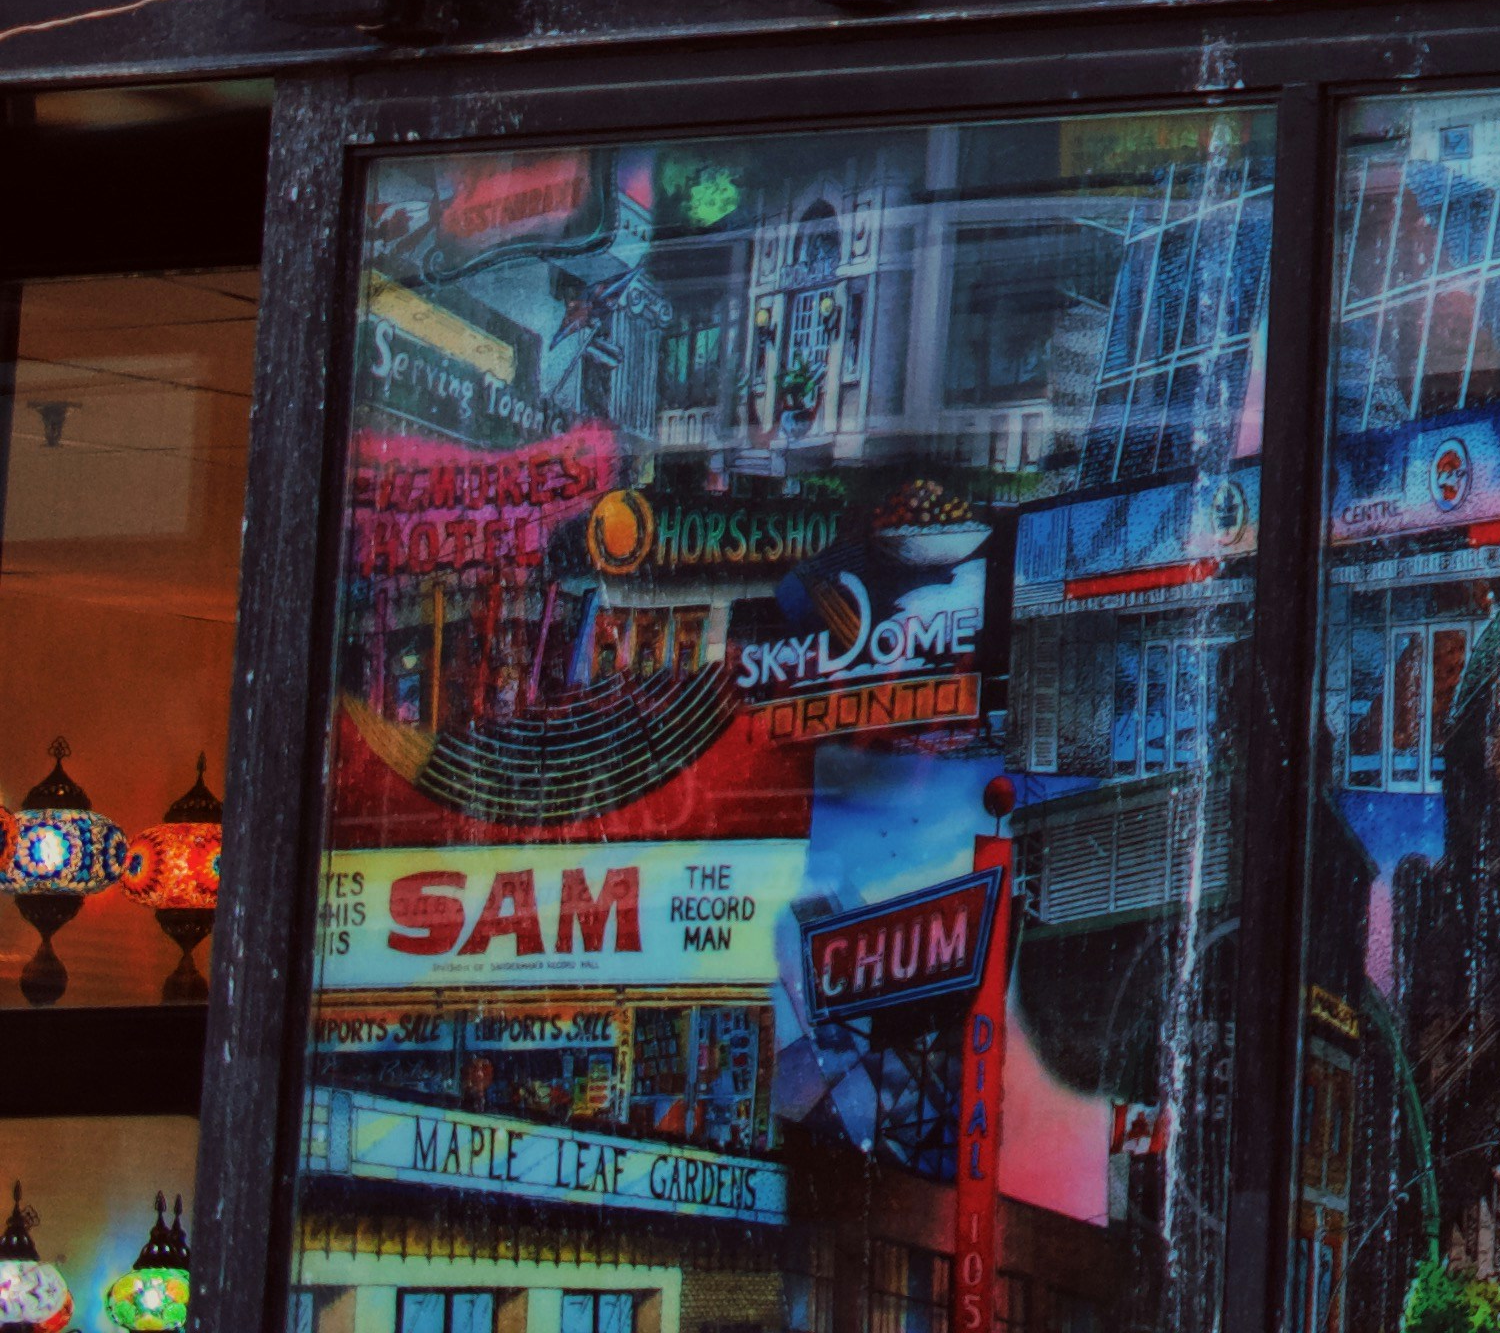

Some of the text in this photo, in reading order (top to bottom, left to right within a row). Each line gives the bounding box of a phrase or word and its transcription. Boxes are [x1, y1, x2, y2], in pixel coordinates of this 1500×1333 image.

[371, 318, 474, 419] Serving
[362, 516, 542, 577] HOTEL
[746, 680, 963, 746] TORONTO
[388, 866, 643, 957] SAM
[670, 895, 756, 923] RECORD
[686, 864, 732, 890] THE
[684, 925, 732, 952] MAN
[821, 907, 969, 999] CHUM
[968, 1014, 995, 1182] DIAL
[412, 1116, 758, 1212] MAPLE LEAF GARDENS
